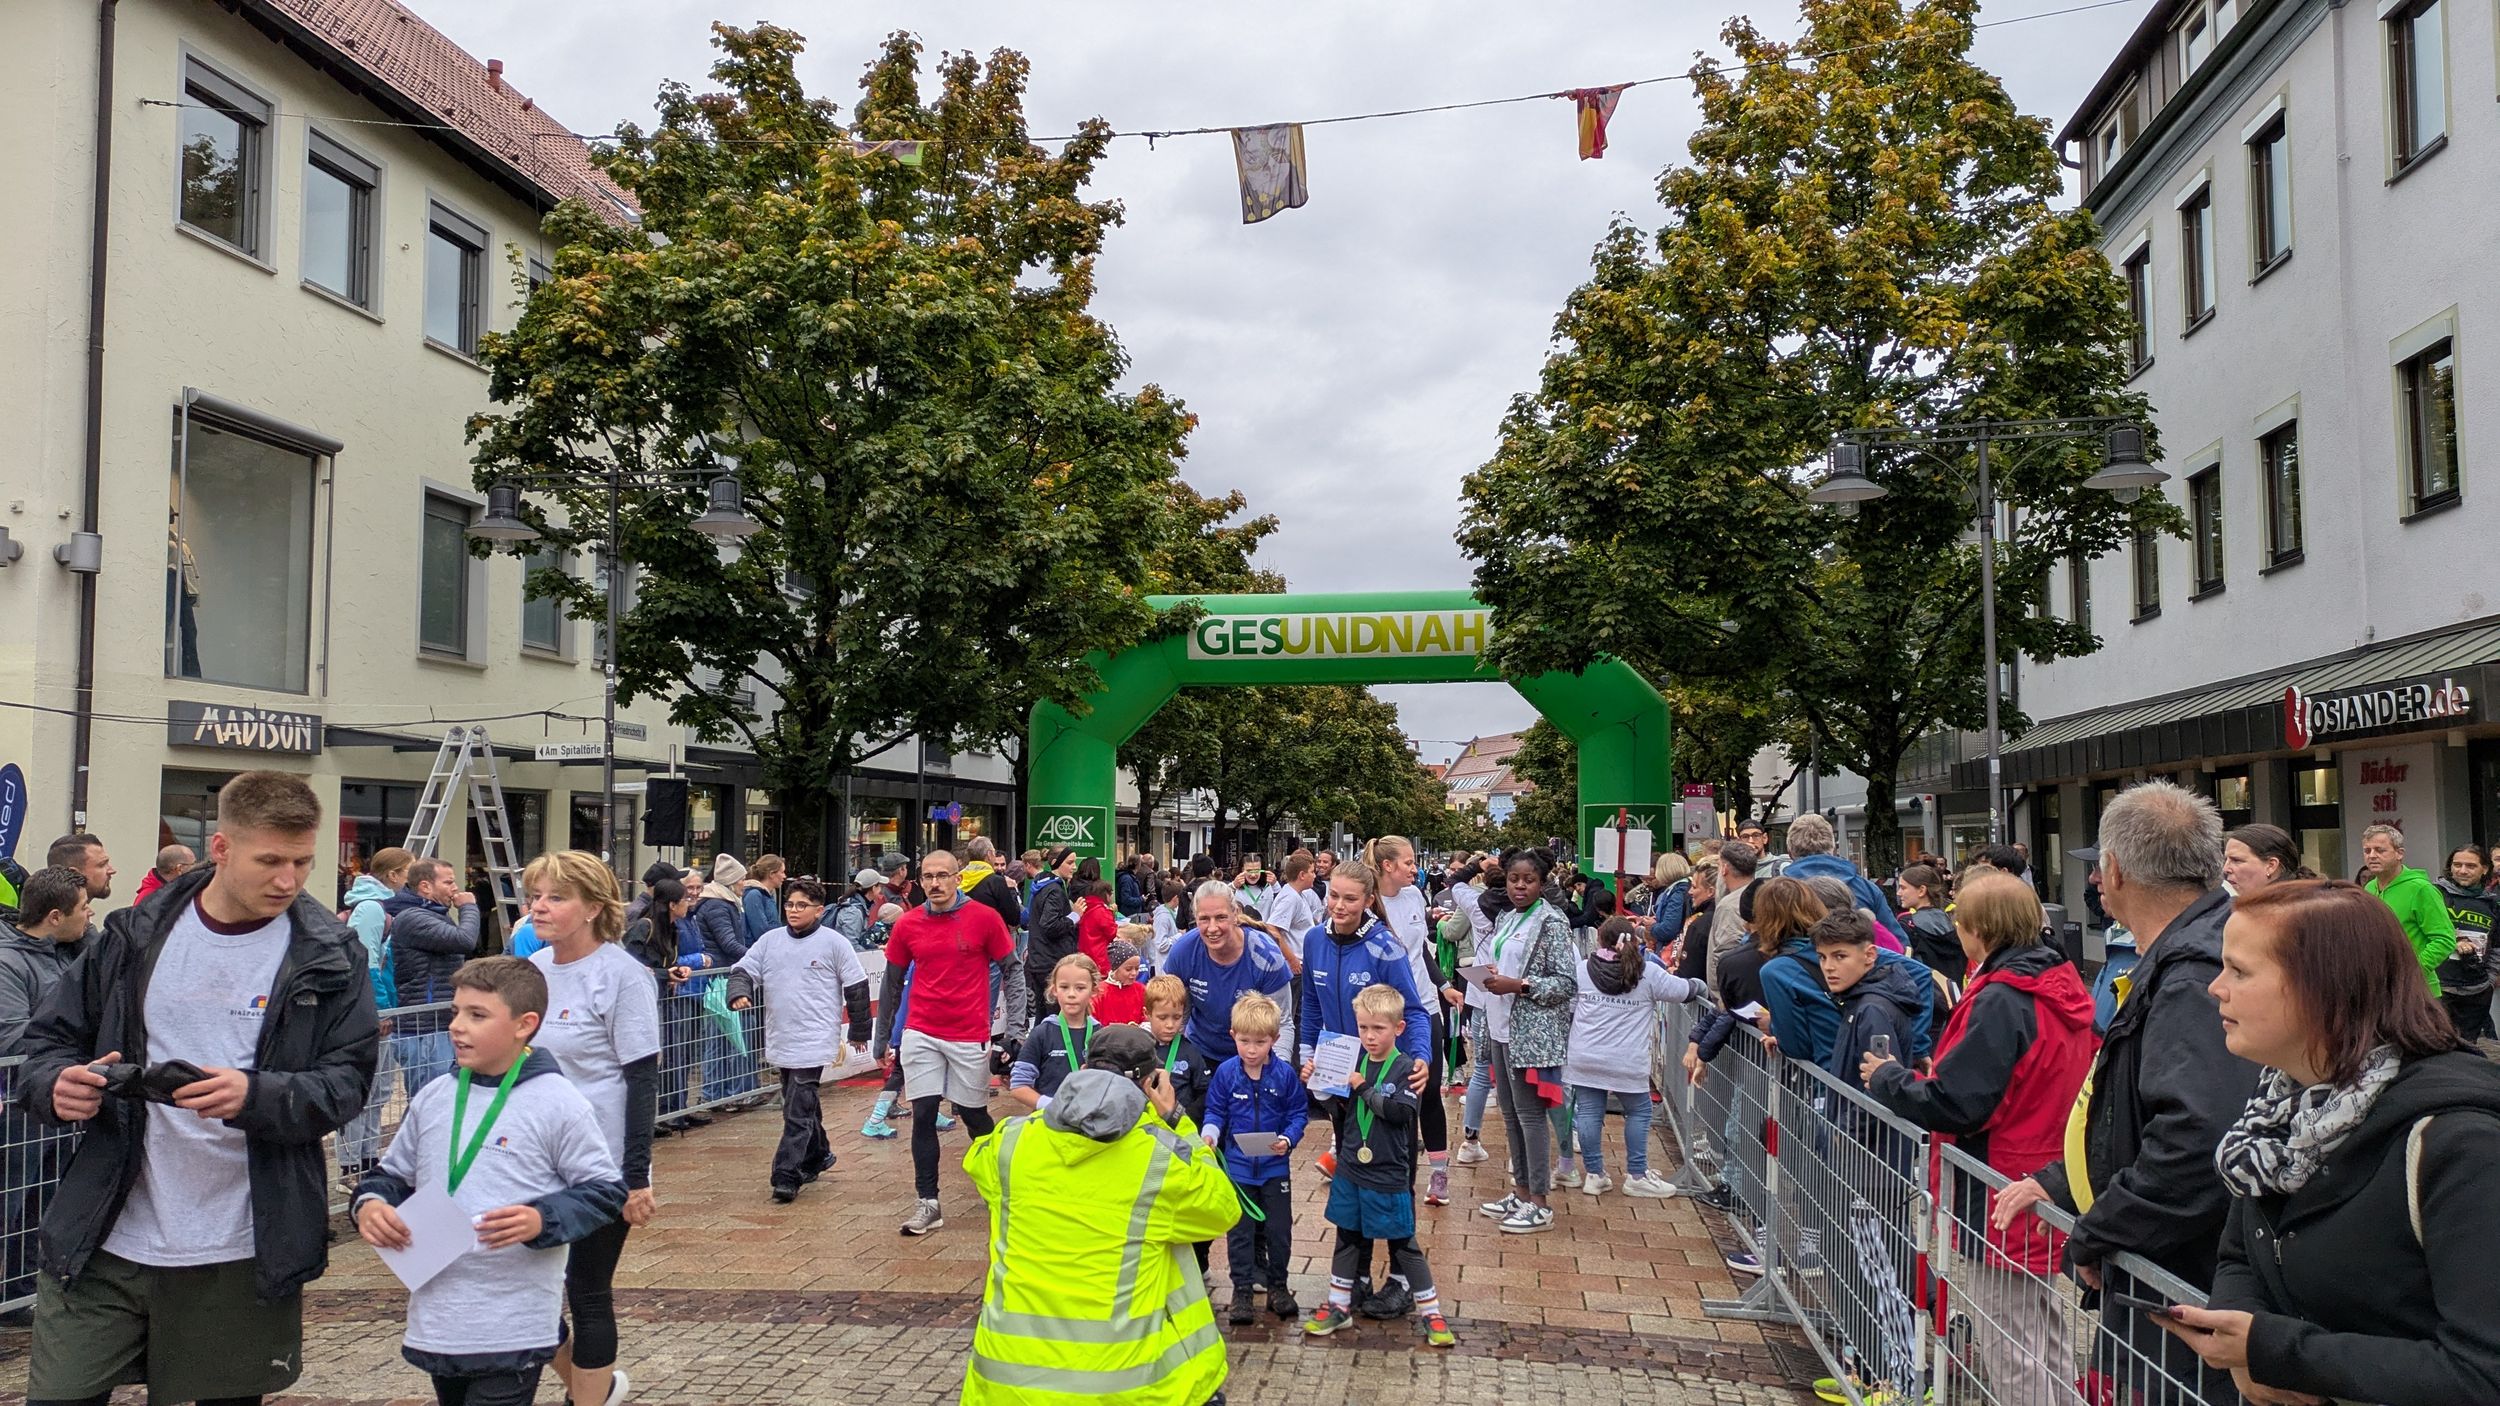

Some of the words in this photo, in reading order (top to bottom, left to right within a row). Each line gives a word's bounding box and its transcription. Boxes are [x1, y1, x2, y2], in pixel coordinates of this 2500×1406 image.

[1196, 613, 1485, 656] GESUNDNAH
[2311, 677, 2470, 735] OSIANDER.de
[194, 706, 312, 751] MADISON
[545, 745, 558, 756] Am
[561, 744, 602, 758] Spitaltörle
[2360, 757, 2409, 785] Bücher
[1037, 815, 1095, 840] AOK
